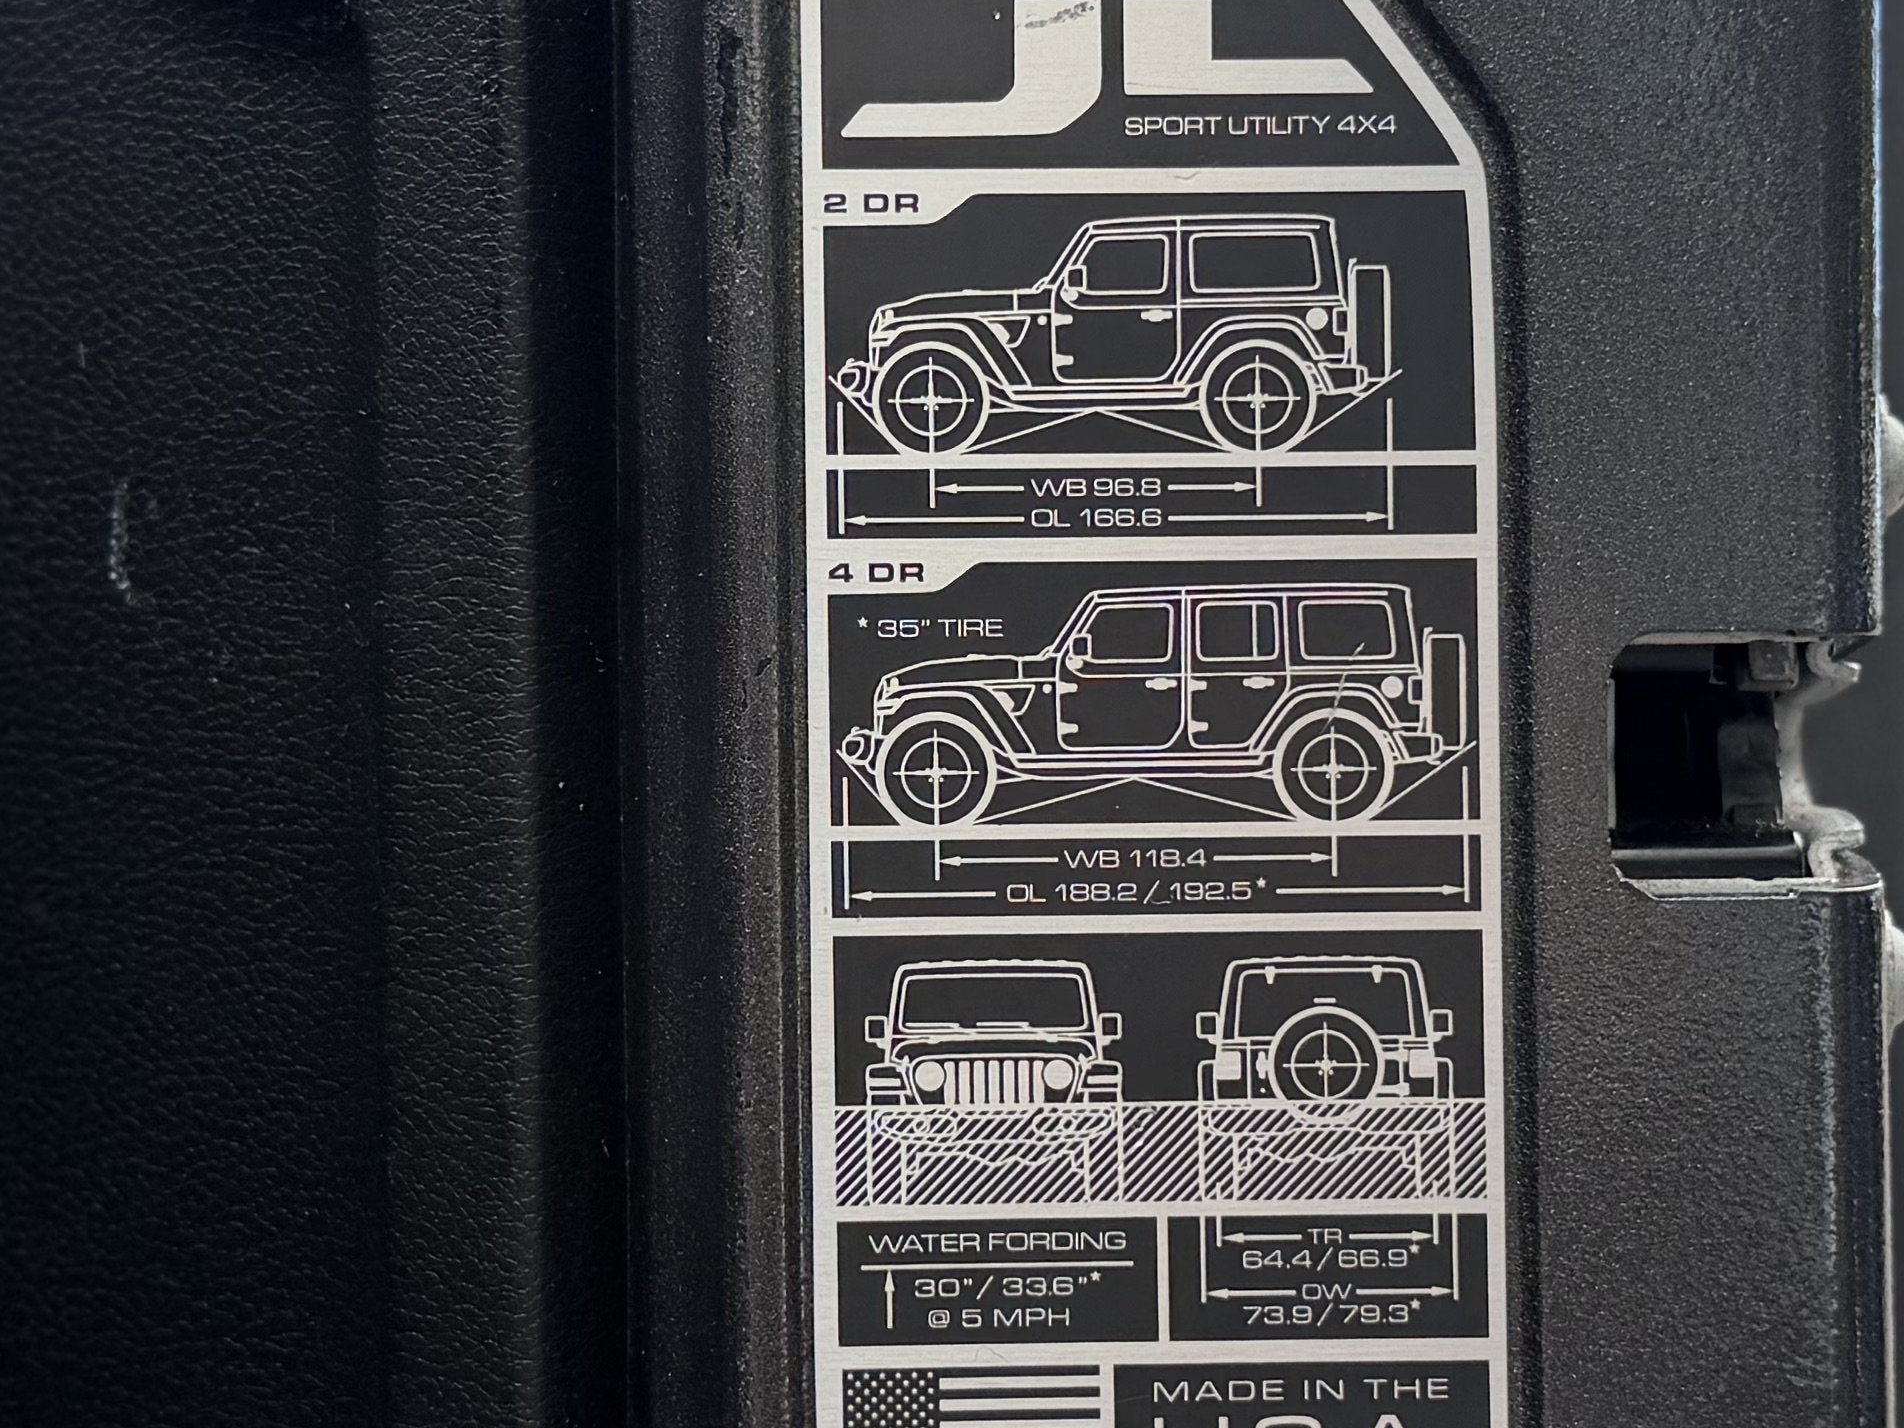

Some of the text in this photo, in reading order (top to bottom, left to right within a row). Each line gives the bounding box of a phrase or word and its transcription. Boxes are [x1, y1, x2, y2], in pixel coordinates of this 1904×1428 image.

[1124, 114, 1397, 136] SPORT UTILITY 4X4
[823, 193, 919, 214] 2 DR
[1030, 477, 1161, 498] WB 96.8
[1031, 508, 1162, 528] OL 166.6
[828, 562, 924, 583] 4 DR
[937, 618, 1004, 638] TIRE
[1063, 848, 1207, 869] WB 118.4
[1006, 883, 1047, 903] OL
[868, 1231, 1127, 1254] WATER FORDING
[1307, 1228, 1342, 1245] TR
[1301, 1283, 1352, 1300] OW
[927, 1307, 1070, 1329] @ 5 MPH
[1153, 1377, 1450, 1403] MADE IN THE
